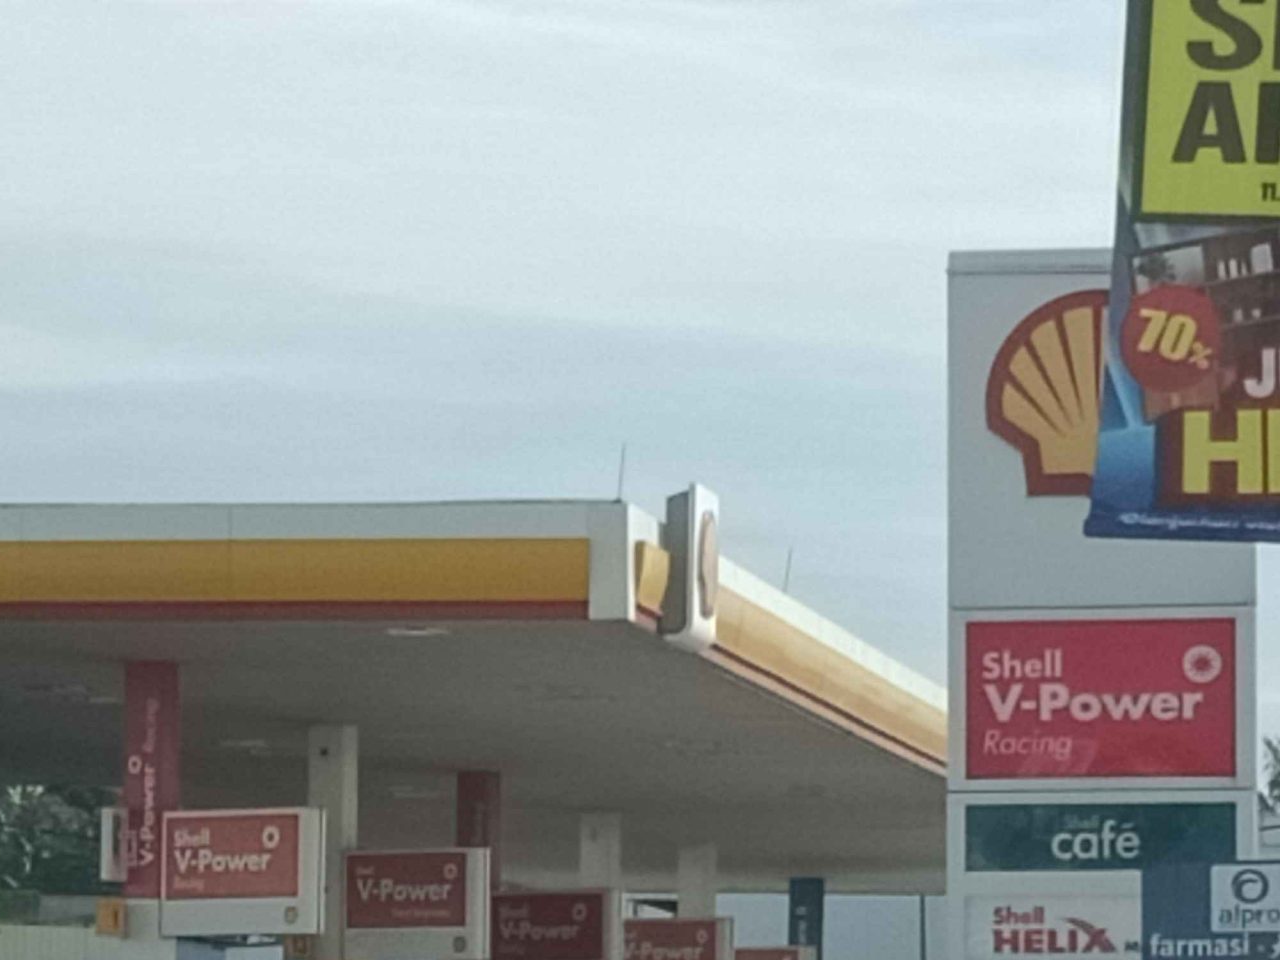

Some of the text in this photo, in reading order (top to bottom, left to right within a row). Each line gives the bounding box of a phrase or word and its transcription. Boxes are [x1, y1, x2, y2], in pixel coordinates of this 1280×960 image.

[1186, 0, 1280, 71] S
[1172, 81, 1280, 164] A
[1138, 308, 1212, 369] 70%
[1243, 348, 1280, 398] J
[1182, 408, 1280, 494] H
[982, 649, 1062, 679] Shell
[983, 683, 1204, 723] V-Power
[983, 730, 1072, 760] Racing
[139, 763, 155, 866] V-Power
[1051, 819, 1141, 861] café
[174, 850, 271, 874] V-Power
[356, 877, 451, 901] V-Power
[500, 921, 580, 940] V-Power
[993, 906, 1045, 924] Shell
[992, 917, 1117, 954] HELIX
[1149, 933, 1249, 957] farmasi
